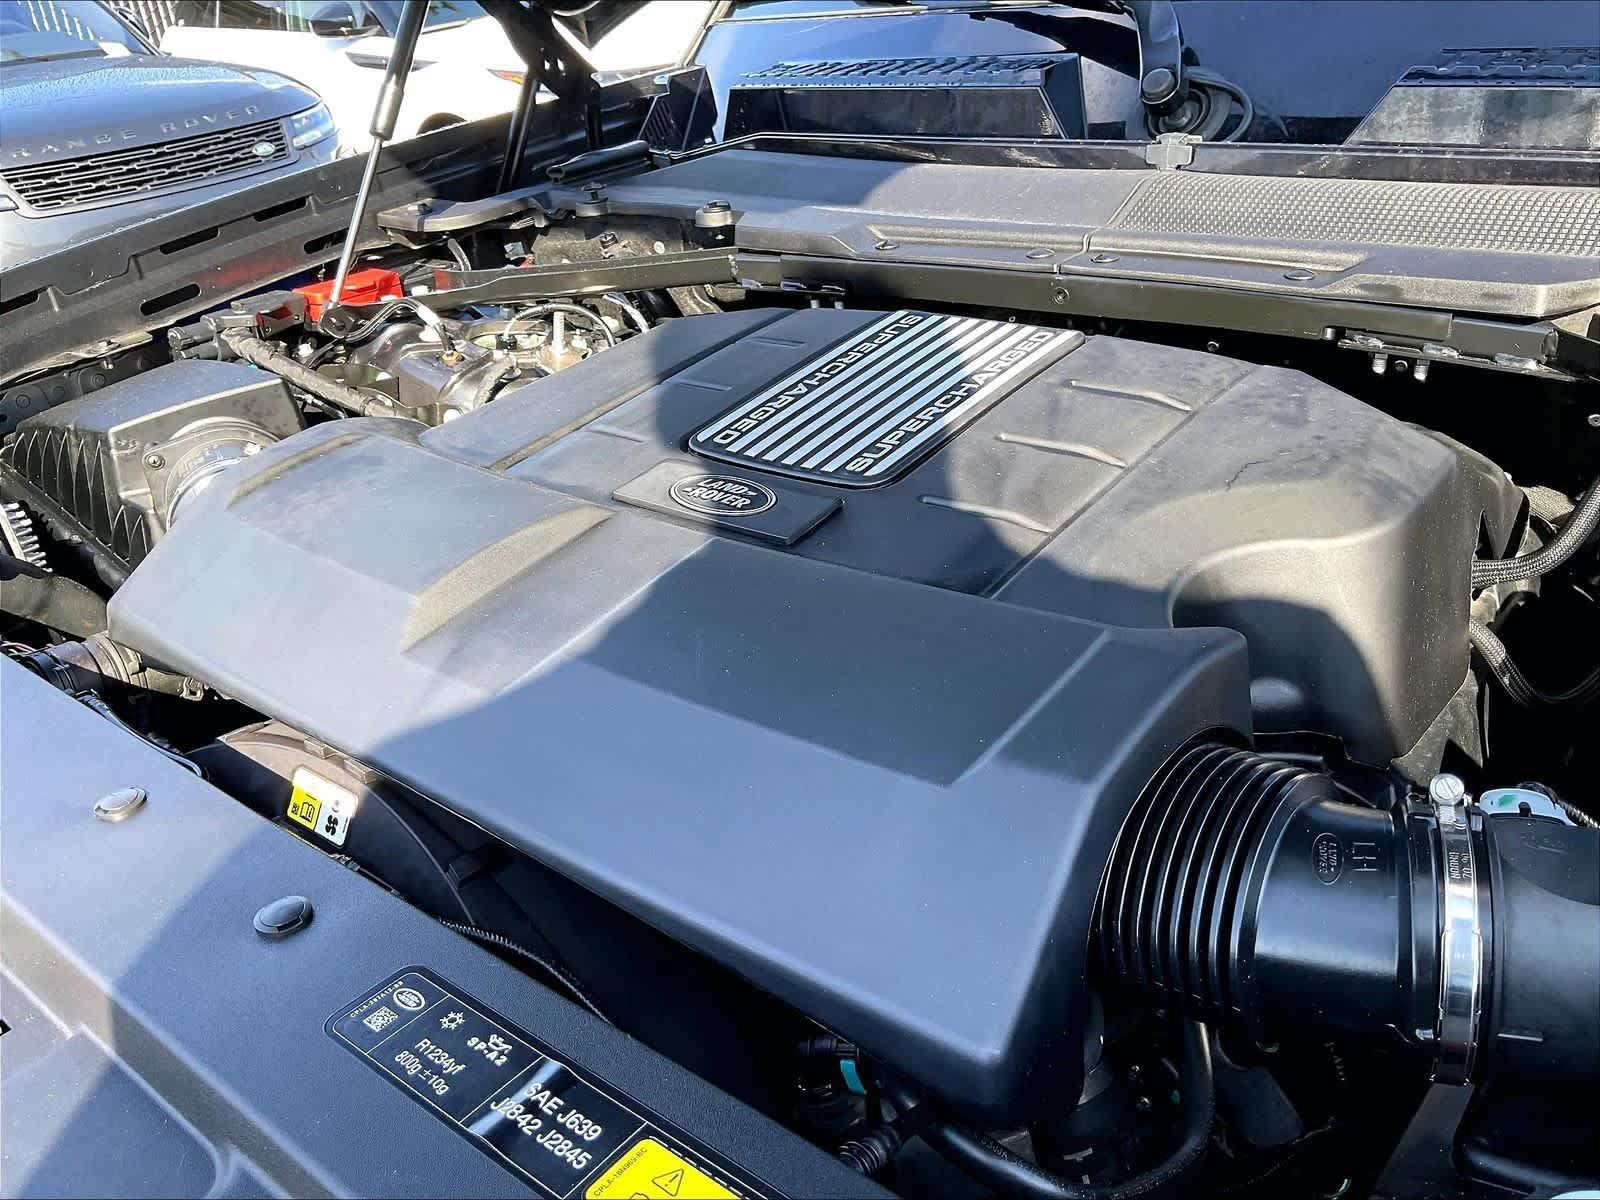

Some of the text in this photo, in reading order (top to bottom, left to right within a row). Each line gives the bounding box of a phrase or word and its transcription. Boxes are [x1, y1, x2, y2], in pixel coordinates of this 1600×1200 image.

[10, 104, 259, 159] RANGE ROVER
[714, 313, 924, 446] SUPERCHARGED
[845, 330, 1054, 474] SUPERCHARGED
[686, 486, 751, 508] ROVER
[697, 478, 749, 494] LAND
[394, 1050, 418, 1075] 800g
[414, 1038, 466, 1076] R1234yf
[490, 1096, 593, 1170] J2842 J2845
[524, 1082, 603, 1142] SAE J639
